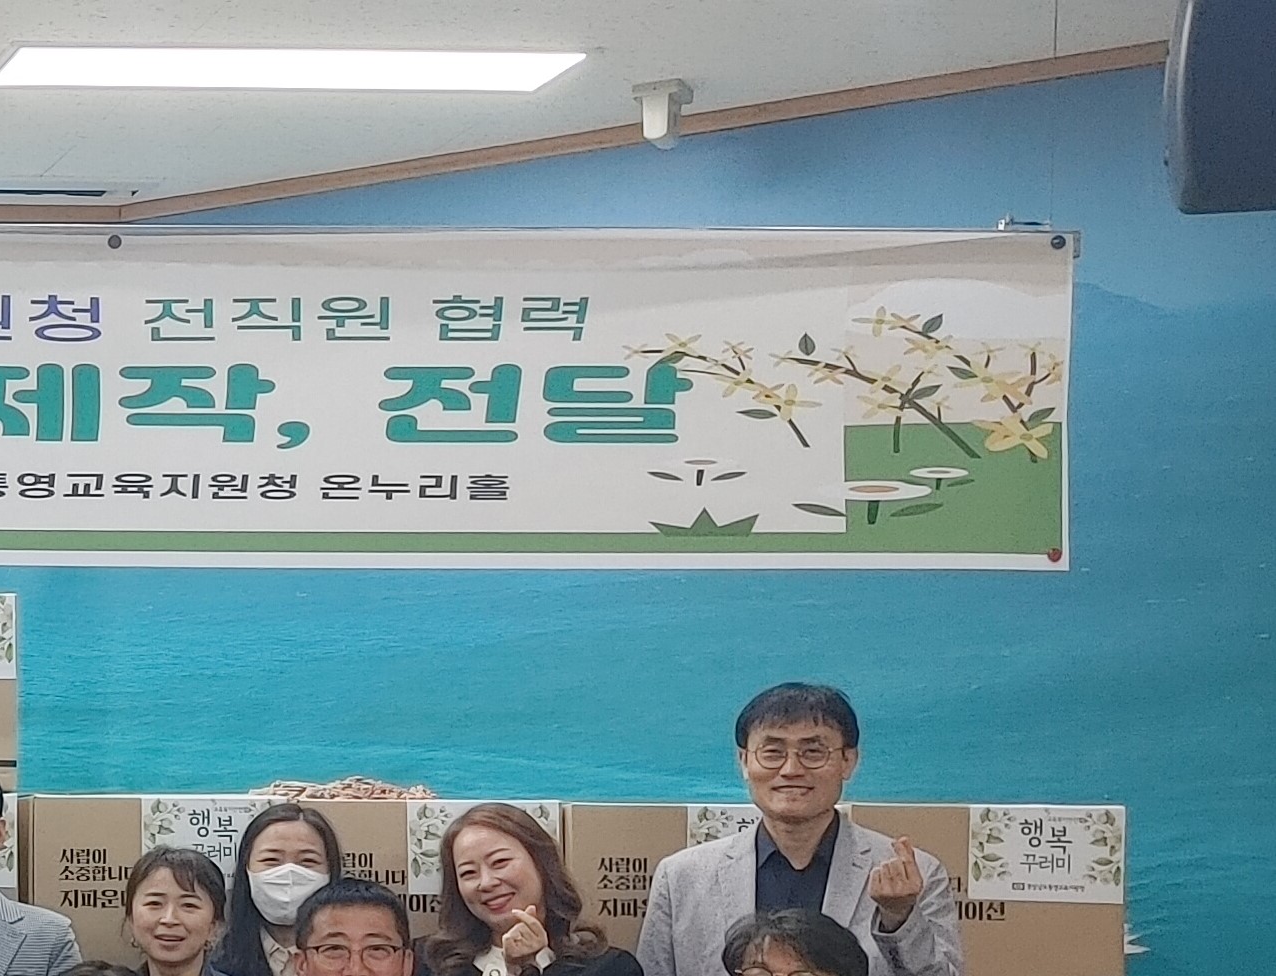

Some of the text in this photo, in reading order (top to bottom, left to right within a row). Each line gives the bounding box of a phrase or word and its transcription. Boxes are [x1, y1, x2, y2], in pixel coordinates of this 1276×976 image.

[141, 294, 391, 342] 전직원
[430, 294, 590, 343] 협력
[376, 361, 694, 444] 전달
[320, 472, 510, 502] 온누리홀
[188, 809, 237, 843] 행복
[1019, 818, 1073, 855] 행복
[60, 848, 107, 864] 사람이
[342, 853, 373, 869] 람이
[598, 857, 647, 873] 사람이
[1020, 854, 1071, 874] 꾸러미
[597, 875, 653, 891] 소중합
[60, 889, 126, 909] 지파운
